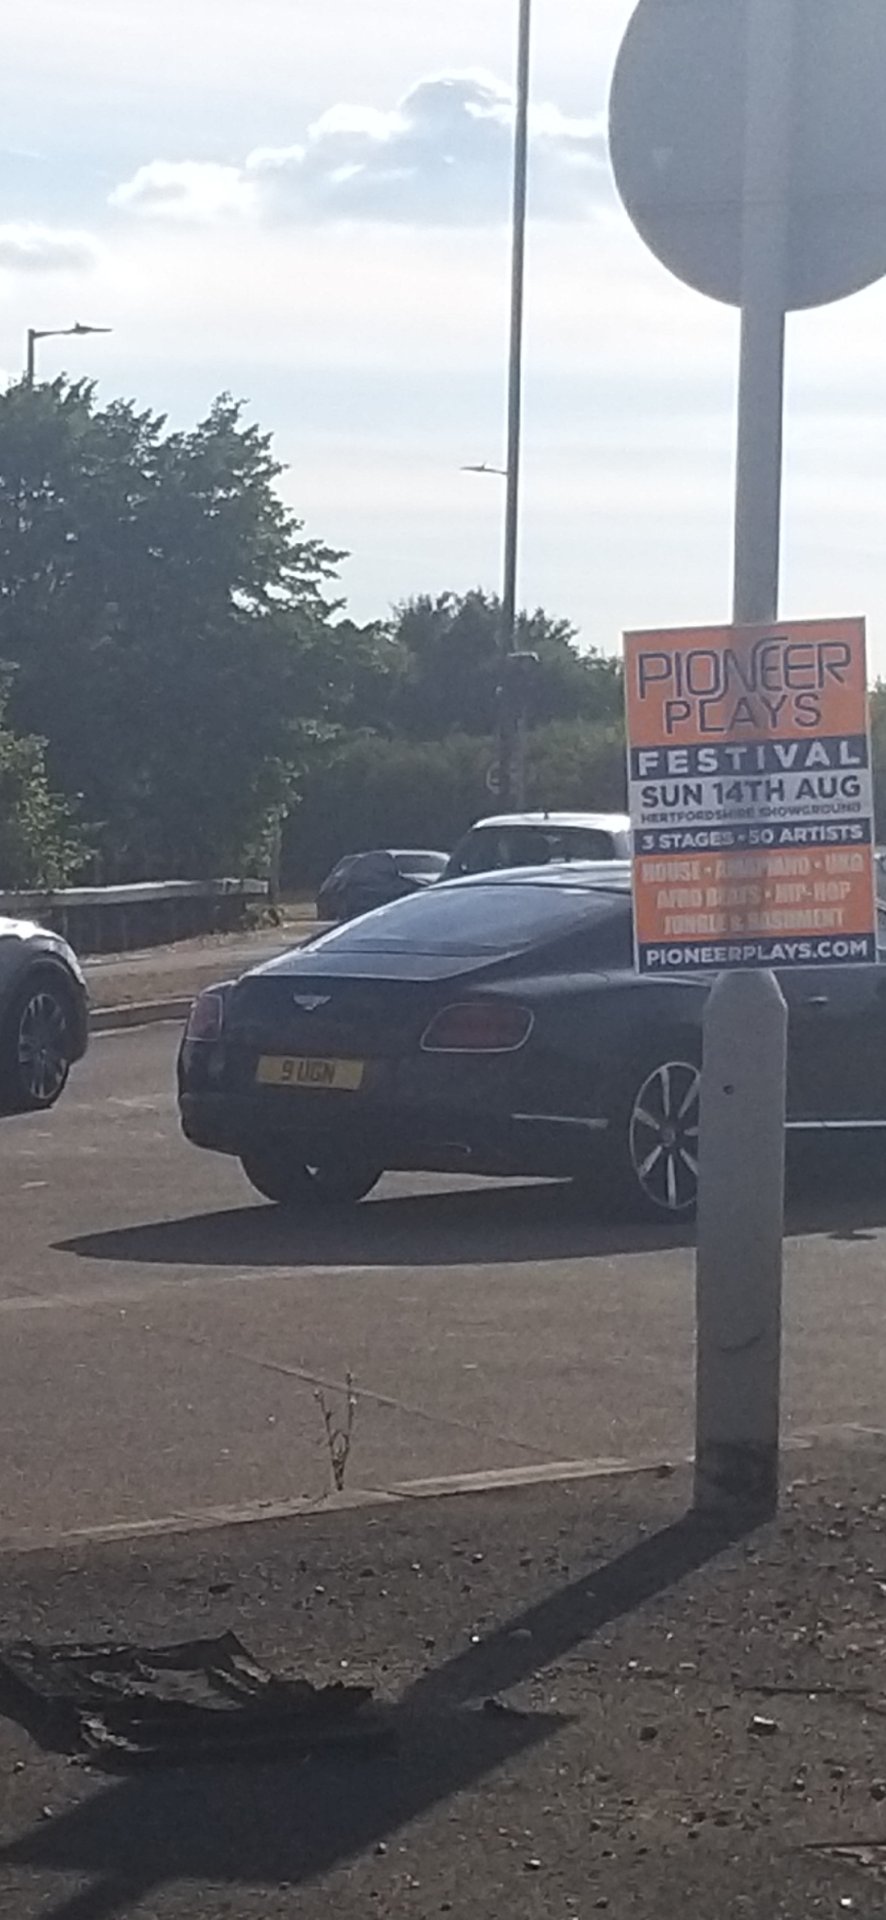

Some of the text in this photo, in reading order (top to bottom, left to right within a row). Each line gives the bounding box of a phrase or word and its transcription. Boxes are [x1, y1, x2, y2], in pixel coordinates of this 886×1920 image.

[637, 636, 851, 700] PIONEER
[664, 692, 822, 735] PLAYS
[638, 740, 861, 777] FESTIVAL
[641, 774, 861, 808] SUN 14TH AUG
[640, 802, 862, 824] HERTFORDSHIRE SHOWGROUND
[641, 823, 864, 849] 3 STAGES 50 ARTISTS
[641, 859, 701, 882] HOUSE
[656, 888, 703, 909] AFRO
[773, 880, 852, 904] HIP-HOP
[646, 940, 868, 966] PIONEERPLAYS.COM
[281, 1059, 295, 1082] 9
